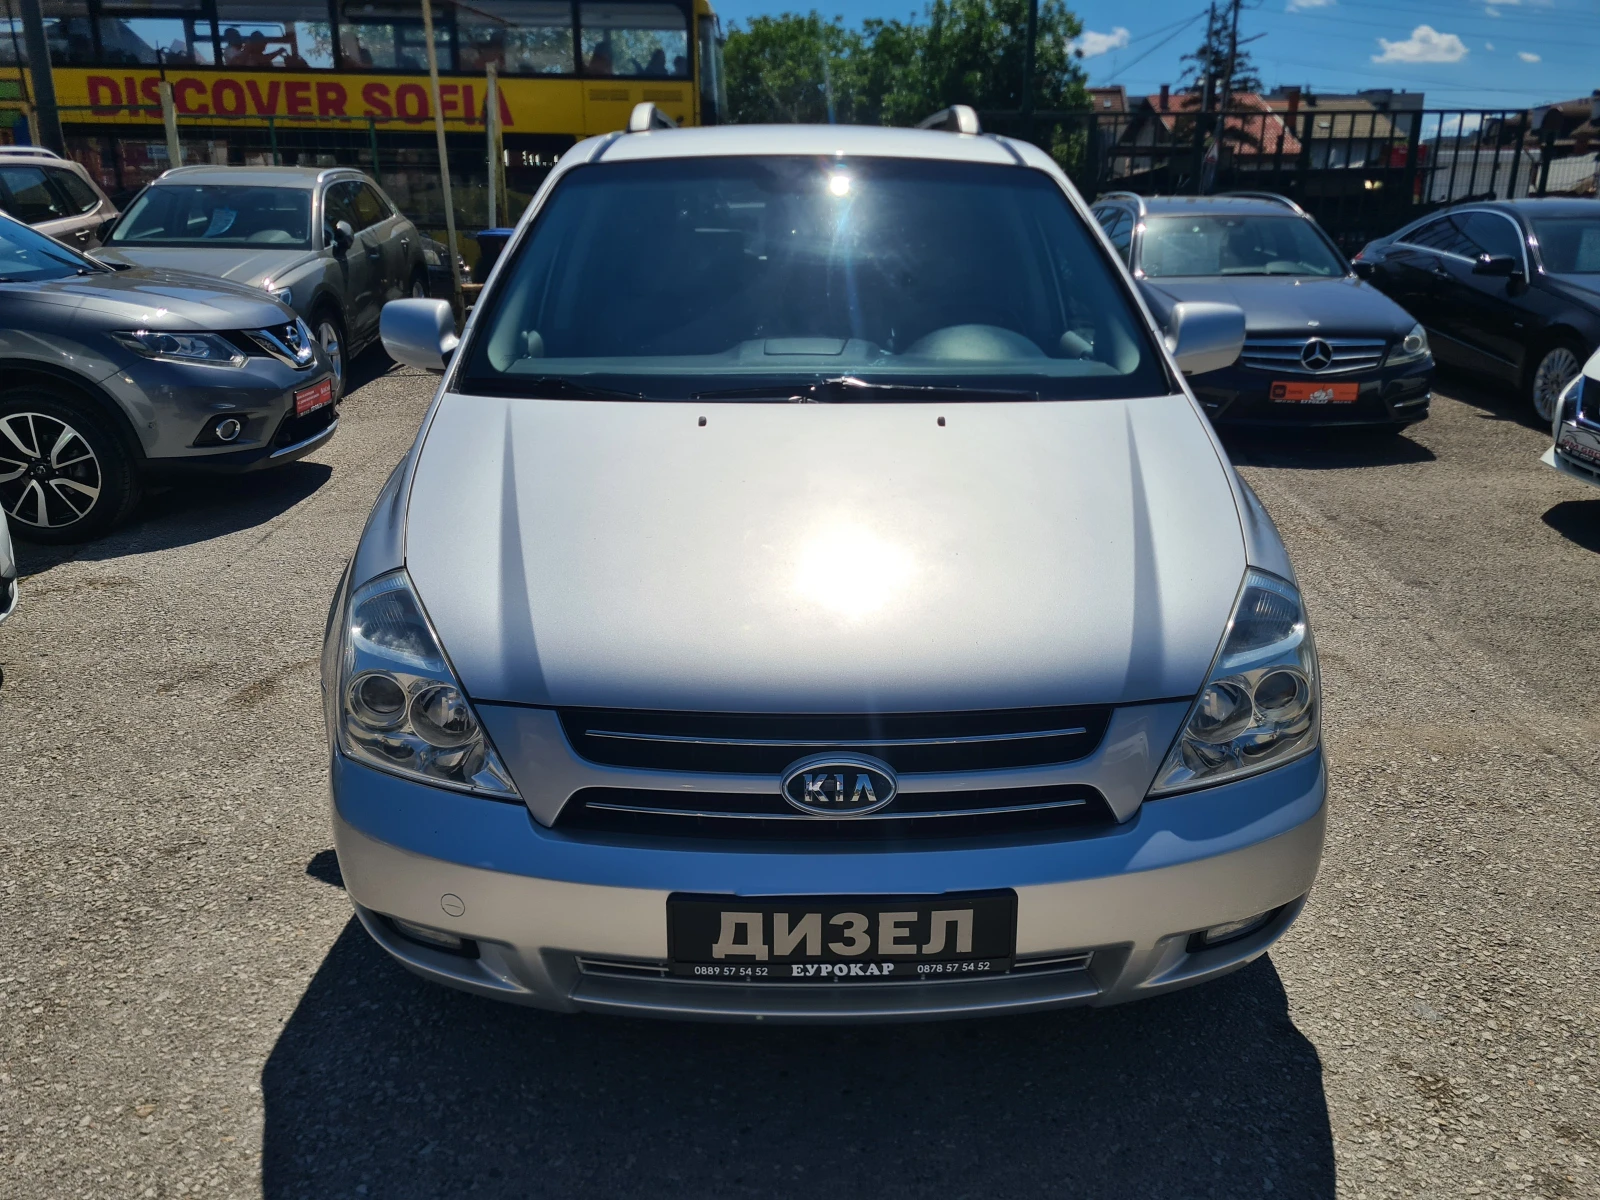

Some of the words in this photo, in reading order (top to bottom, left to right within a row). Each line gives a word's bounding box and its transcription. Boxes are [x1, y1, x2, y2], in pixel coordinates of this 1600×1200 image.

[87, 75, 351, 122] DISCOVER
[803, 774, 877, 802] KIA
[712, 909, 974, 960] ДИЗЕЛ
[694, 966, 720, 975] 0889
[723, 967, 736, 975] 57
[739, 967, 752, 976] 54
[755, 967, 768, 976] 52
[791, 962, 895, 977] ЕУРОКАР
[917, 964, 943, 974] 0878
[946, 963, 959, 972] 57
[961, 962, 975, 971] 54
[977, 961, 990, 971] 52
